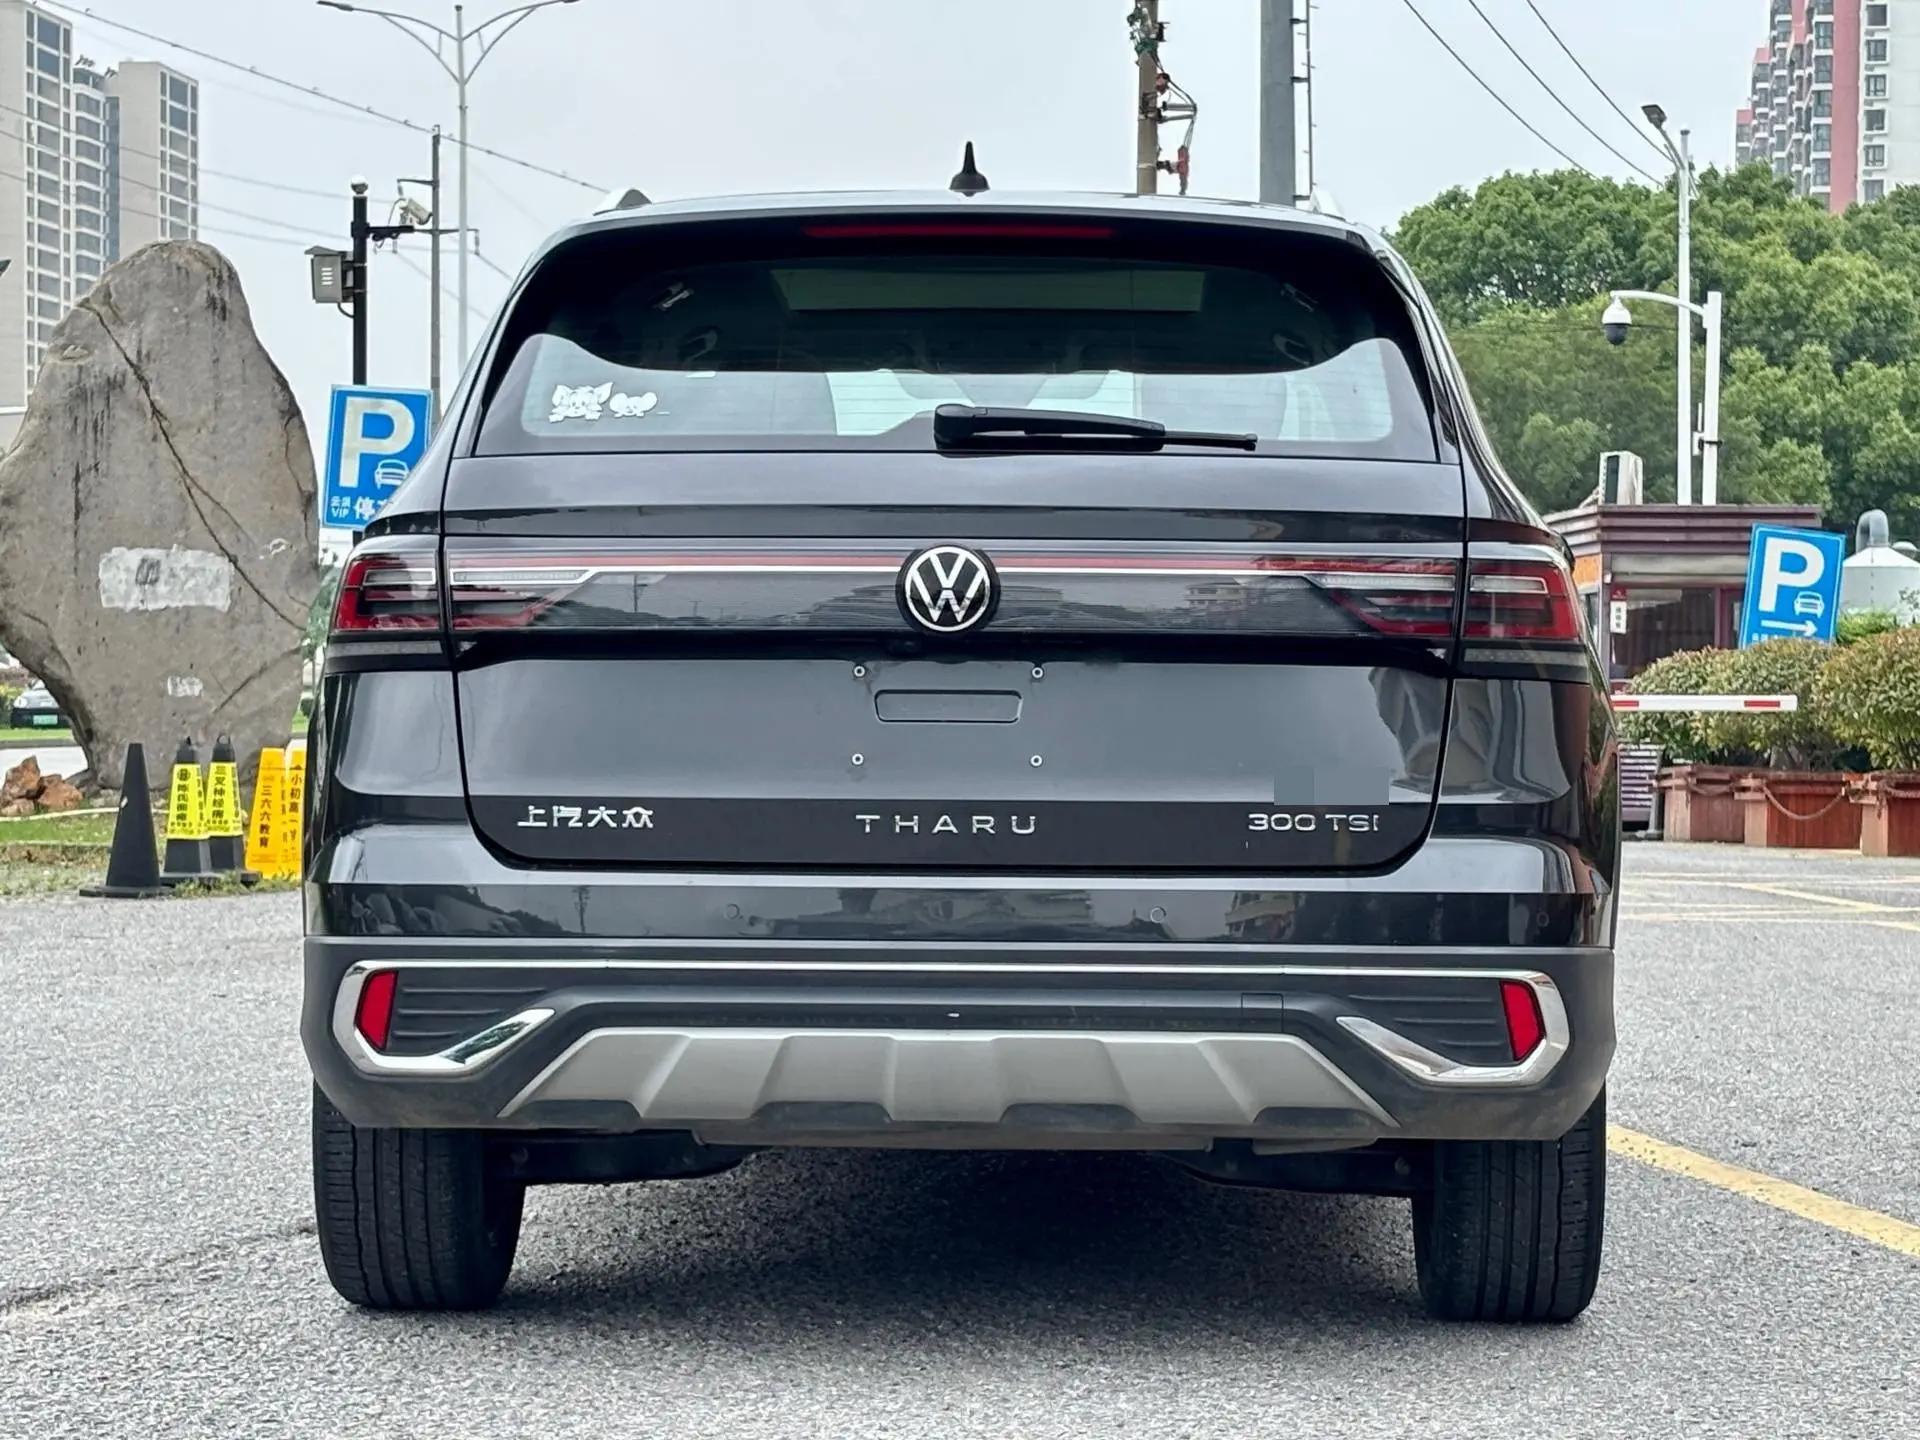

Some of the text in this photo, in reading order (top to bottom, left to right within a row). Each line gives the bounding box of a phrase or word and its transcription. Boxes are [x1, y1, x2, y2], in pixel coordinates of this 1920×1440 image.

[339, 395, 415, 488] P
[331, 507, 350, 518] VIP
[1758, 536, 1825, 613] P
[259, 785, 273, 848] 三六六教育
[517, 805, 653, 828] 上汽大众
[856, 815, 1036, 834] THARU
[1248, 813, 1379, 832] 300 TSI
